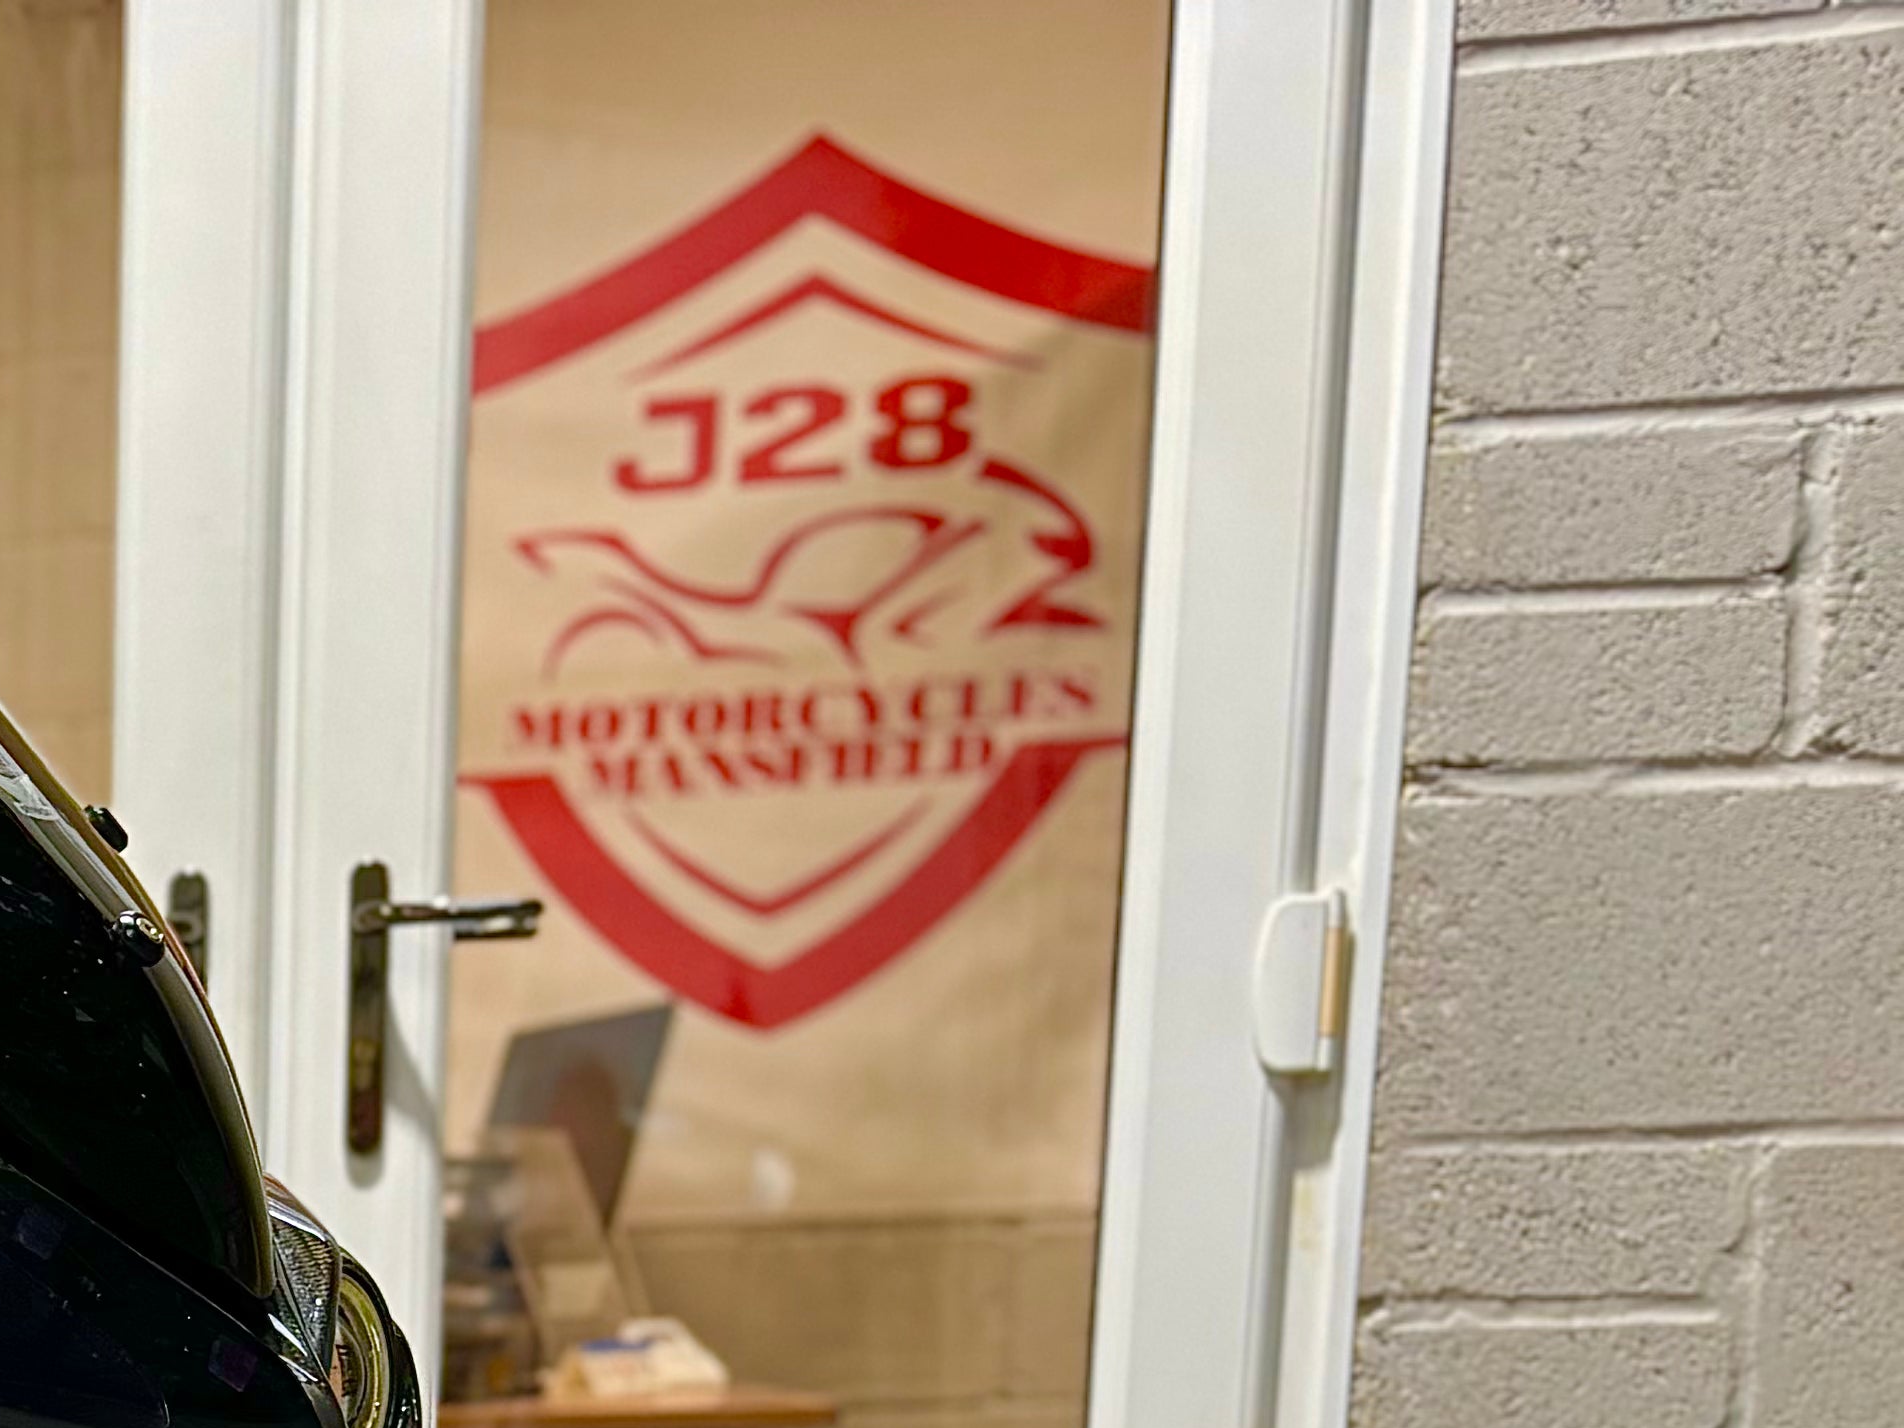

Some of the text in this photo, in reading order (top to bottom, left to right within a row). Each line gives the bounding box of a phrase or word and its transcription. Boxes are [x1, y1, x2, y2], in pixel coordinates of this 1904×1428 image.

[614, 374, 975, 495] J28
[507, 670, 1098, 752] MOTORCYCLES
[586, 732, 999, 800] MANSFIELD
